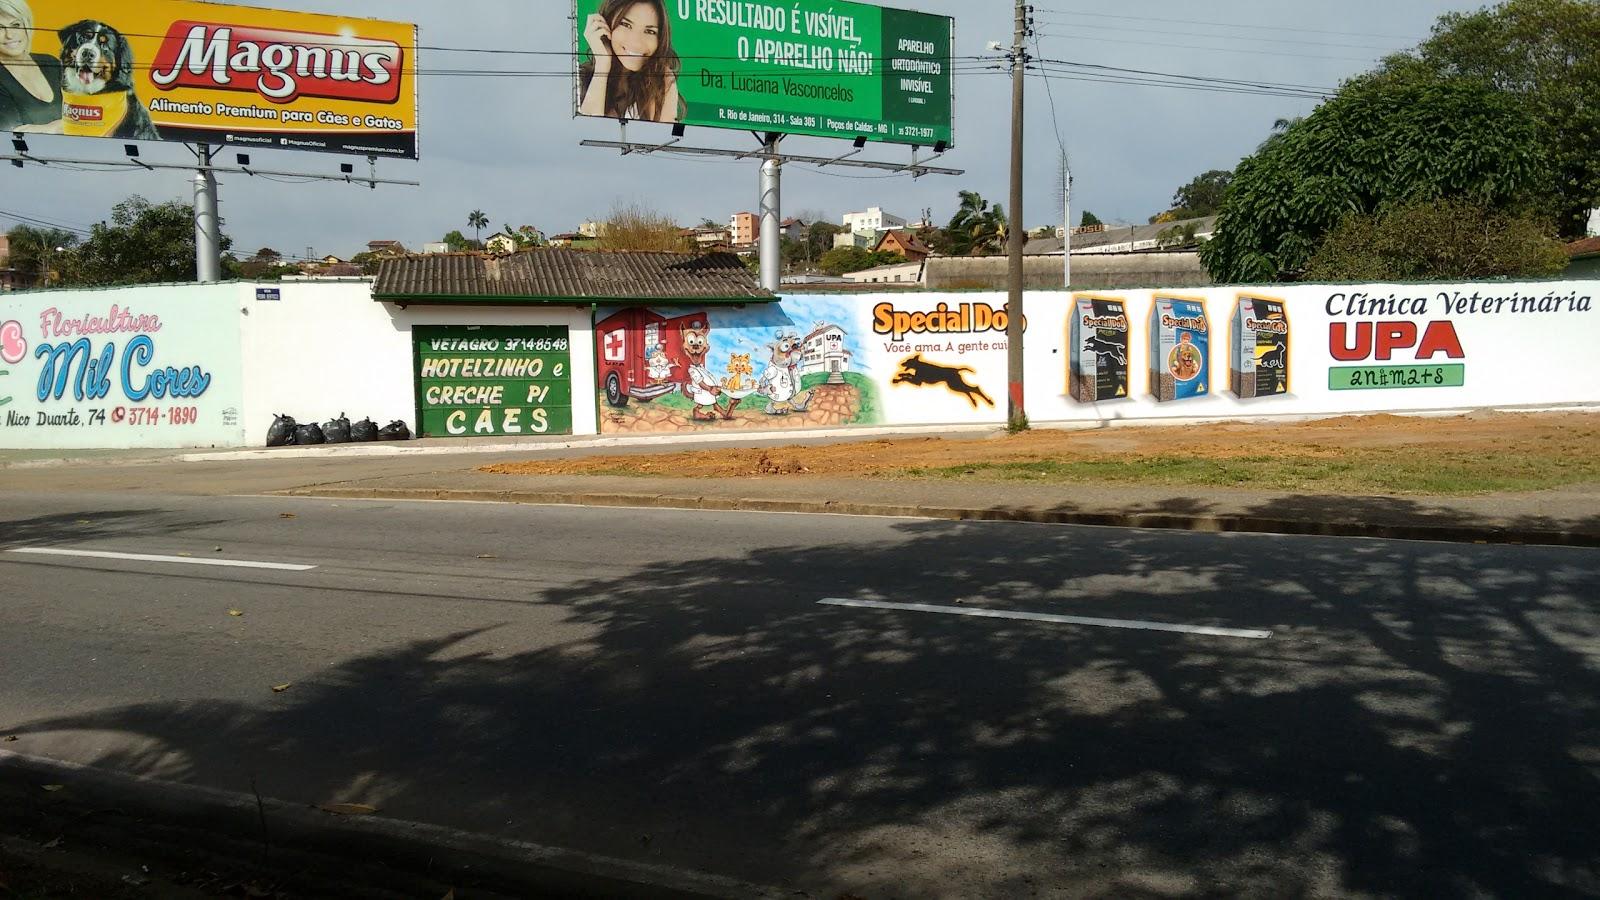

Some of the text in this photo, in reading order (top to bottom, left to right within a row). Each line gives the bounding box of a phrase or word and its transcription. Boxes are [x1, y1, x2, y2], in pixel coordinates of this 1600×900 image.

[678, 0, 862, 45] O RESULTADO É VISÍVEL,
[737, 36, 873, 76] O APARELHO NÃO!
[898, 38, 935, 55] APARELHO
[152, 25, 392, 98] Magnus
[892, 57, 941, 75] ORTODÔNTICO
[701, 68, 854, 102] Dra. Luciana Vasconcelos
[900, 77, 934, 94] INVISÍVEL
[150, 98, 403, 129] Alimento Premium para Cães e Gatos
[719, 108, 726, 119] R.
[727, 109, 738, 121] Rio
[738, 111, 747, 121] de
[748, 111, 772, 124] Janeiro,
[773, 113, 785, 124] 314
[789, 115, 803, 126] Sala
[803, 116, 816, 128] 305
[826, 118, 844, 131] Poços
[845, 120, 854, 131] de
[854, 121, 874, 132] Caldas
[878, 123, 888, 134] MG
[904, 126, 934, 138] 3721-1977
[1325, 291, 1592, 316] Clínica Veterinária
[40, 304, 162, 338] Floricultura
[873, 302, 970, 341] Special
[1082, 314, 1111, 329] Special
[1162, 314, 1190, 329] Special
[1245, 317, 1271, 332] Special
[431, 338, 499, 351] VETAGRO
[884, 342, 911, 353] Você
[946, 341, 954, 351] A
[958, 341, 989, 354] gente
[1329, 320, 1465, 361] UPA
[35, 335, 211, 402] Mil Cores
[421, 358, 563, 377] HOTELZINHO e
[426, 385, 549, 405] CRECHE P/
[6, 406, 197, 427] Nico Duarte, 74 3714-1890
[446, 405, 549, 435] CÃES
